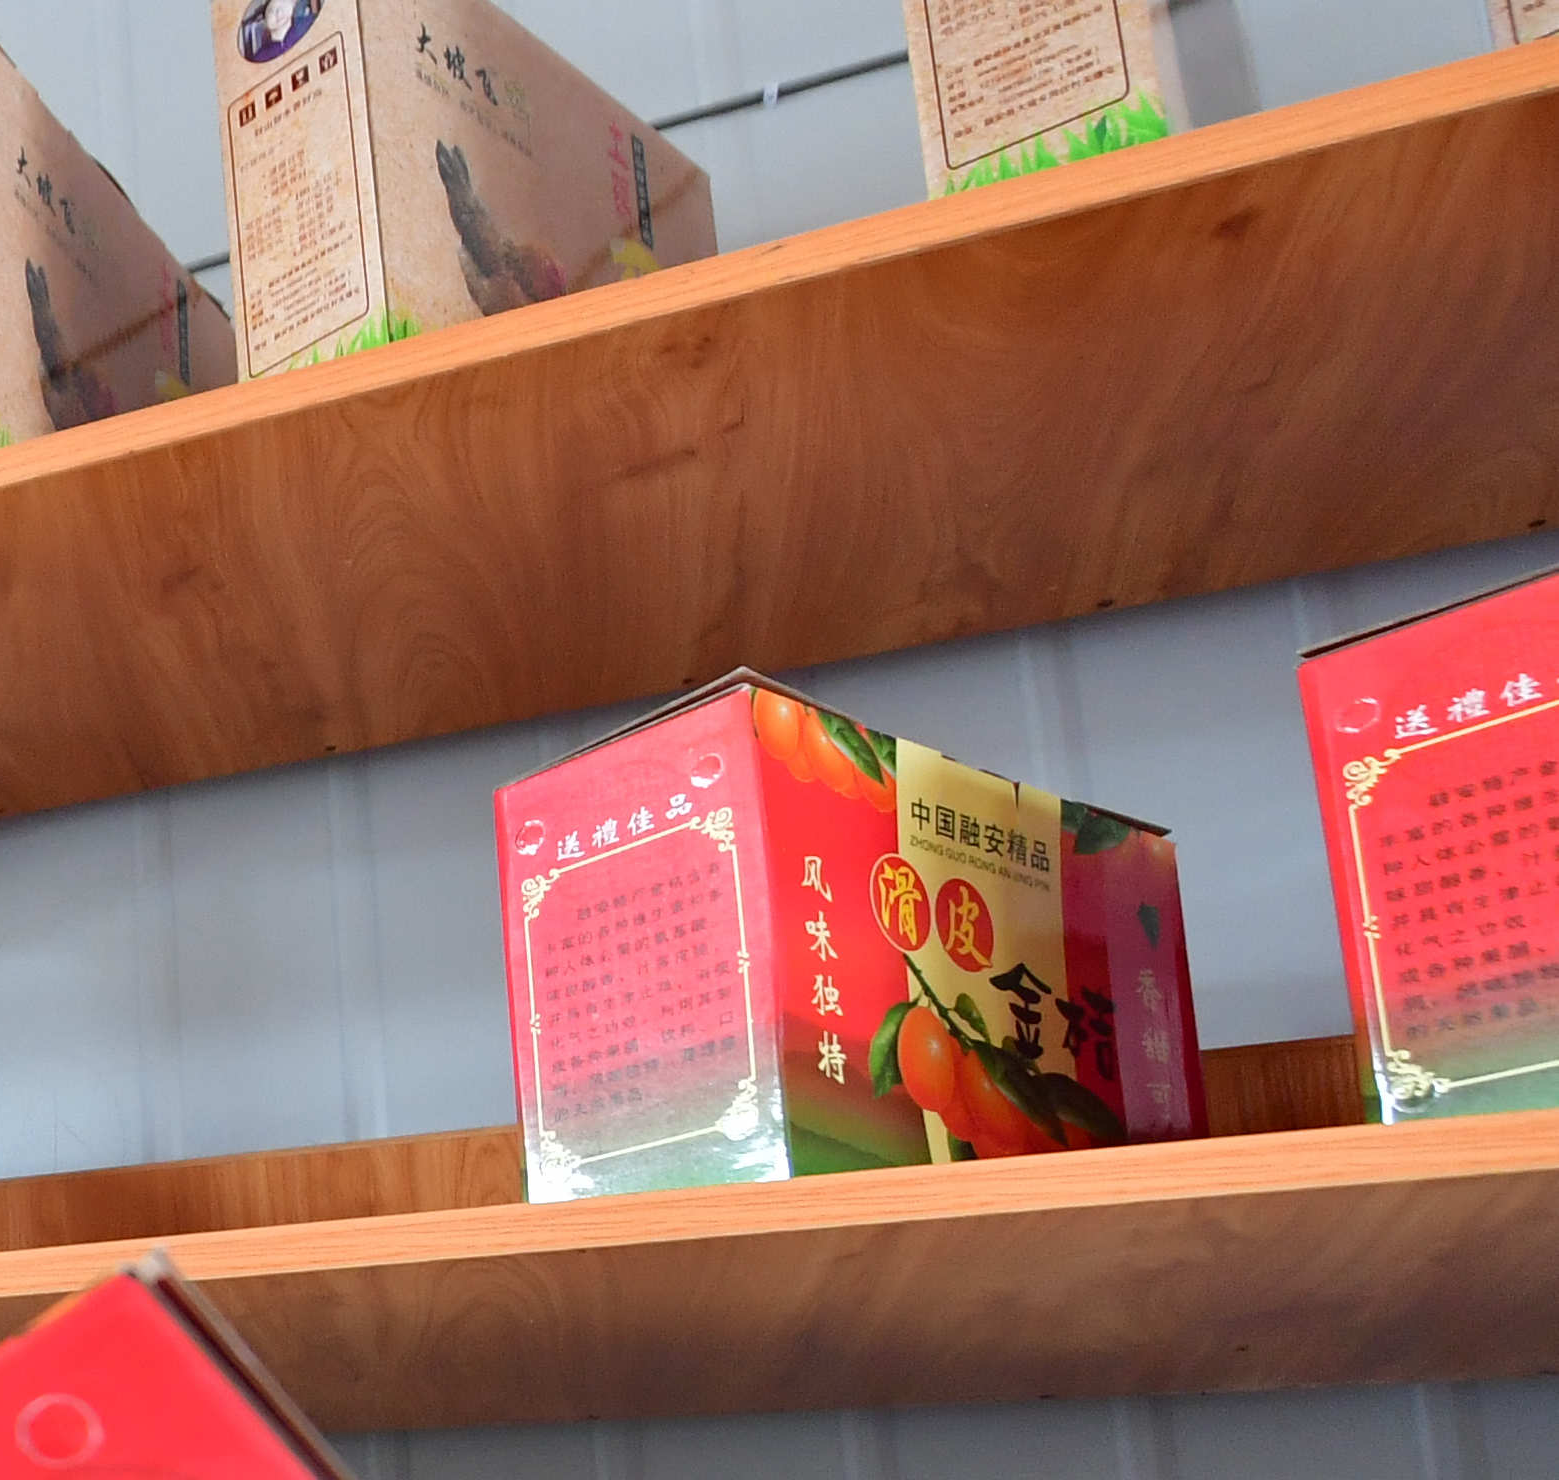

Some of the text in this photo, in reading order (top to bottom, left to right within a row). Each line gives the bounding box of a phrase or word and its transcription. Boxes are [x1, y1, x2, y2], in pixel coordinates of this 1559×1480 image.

[910, 798, 1051, 873] 中国融安精品
[910, 834, 944, 858] ZHONG
[945, 845, 968, 864] GUO
[968, 853, 996, 876] RONG
[879, 861, 993, 968] 滑皮
[800, 855, 848, 1086] 风味独特
[989, 963, 1117, 1081] 金桔
